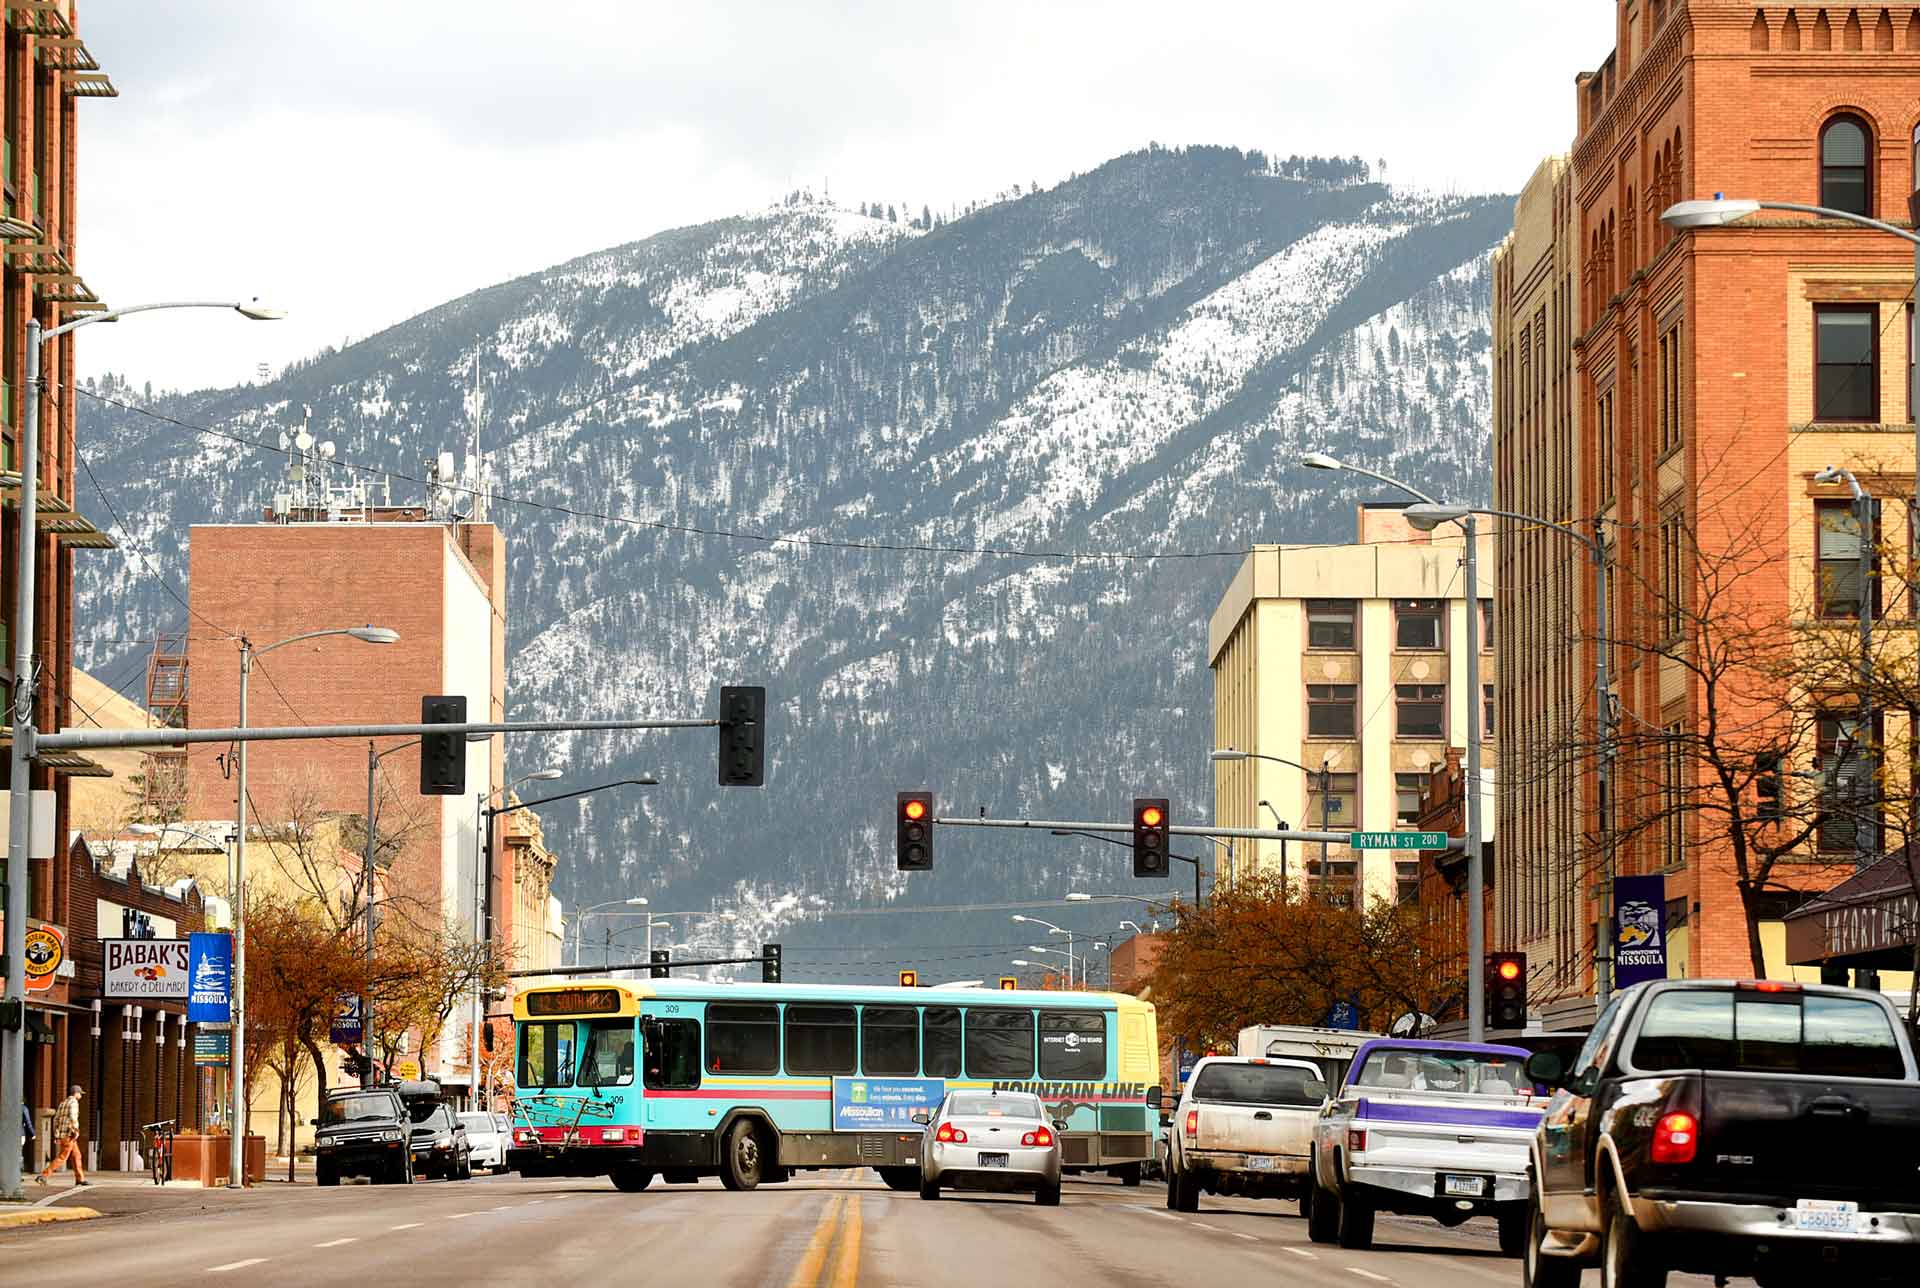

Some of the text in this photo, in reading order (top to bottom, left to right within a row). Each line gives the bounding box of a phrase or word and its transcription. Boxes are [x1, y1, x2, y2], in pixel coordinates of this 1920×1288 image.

[1360, 834, 1437, 847] RYMAN ST 200
[109, 943, 189, 971] BABAK'S
[1617, 954, 1664, 965] MISSOULA
[110, 981, 139, 993] BAKERY
[140, 981, 148, 993] &
[166, 981, 187, 993] MART
[191, 996, 228, 1004] MISSOULA
[665, 1004, 680, 1014] 309
[992, 1081, 1145, 1099] MOUNTAIN LINE
[610, 1095, 624, 1104] 309
